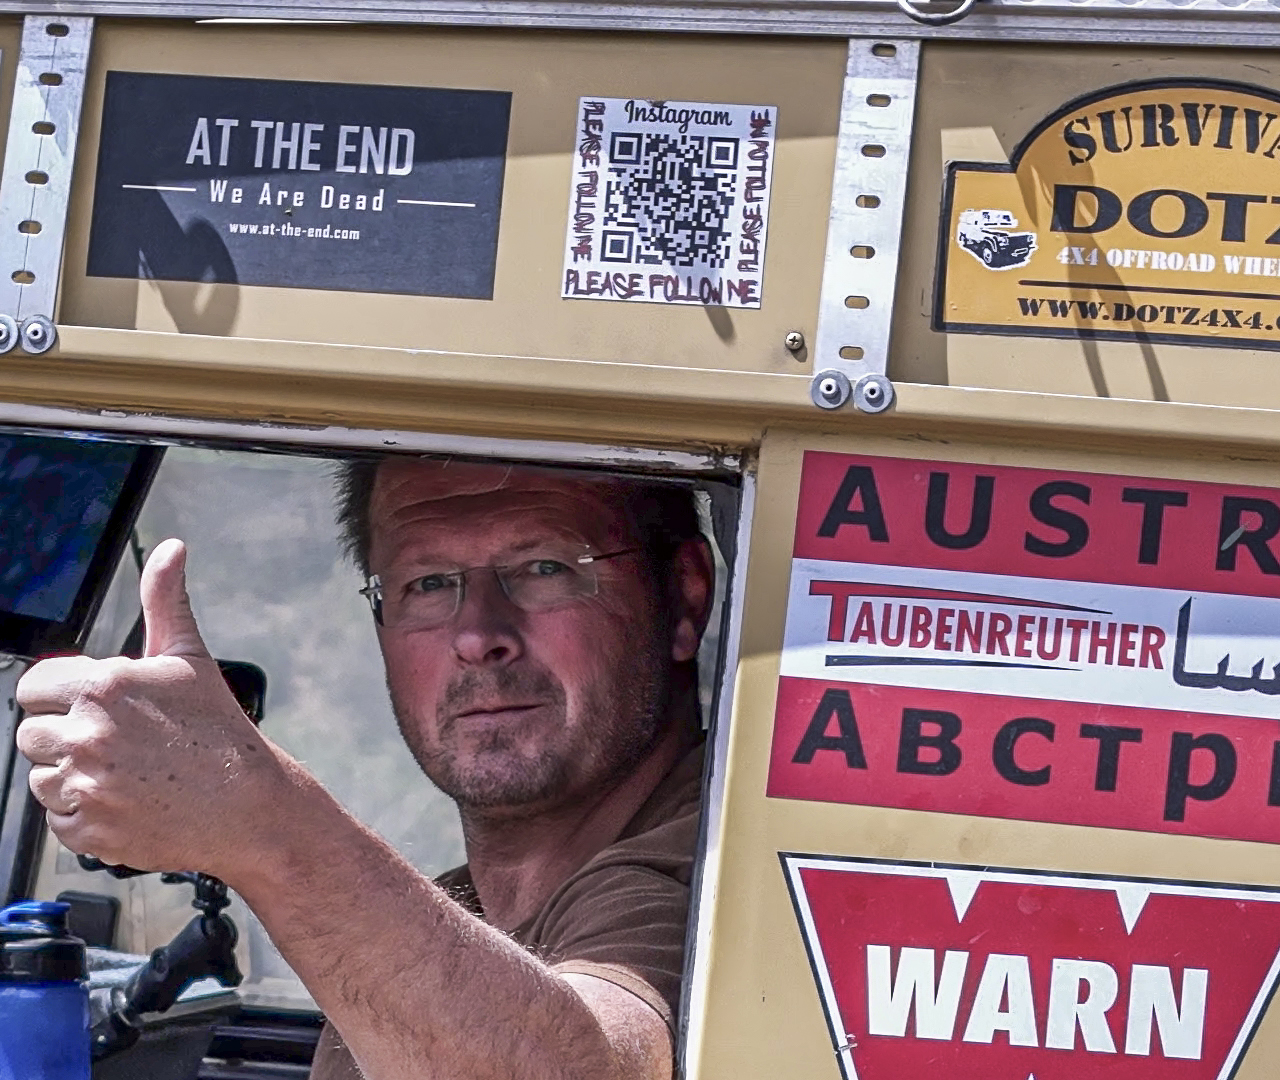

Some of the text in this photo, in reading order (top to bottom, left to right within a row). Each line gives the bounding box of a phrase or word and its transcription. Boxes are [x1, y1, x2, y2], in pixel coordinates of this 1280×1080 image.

[624, 100, 733, 134] Instagram
[186, 117, 416, 176] AT THE END
[210, 179, 384, 211] We Are Dead
[229, 222, 360, 240] www.at-the-end.com
[1056, 246, 1099, 267] 4X4
[1107, 248, 1216, 273] OFFROAD
[565, 269, 644, 299] PLEASE
[649, 274, 722, 304] FOLLOW
[809, 580, 1167, 670] TAUBENREUTHER
[865, 944, 1209, 1061] WARN
